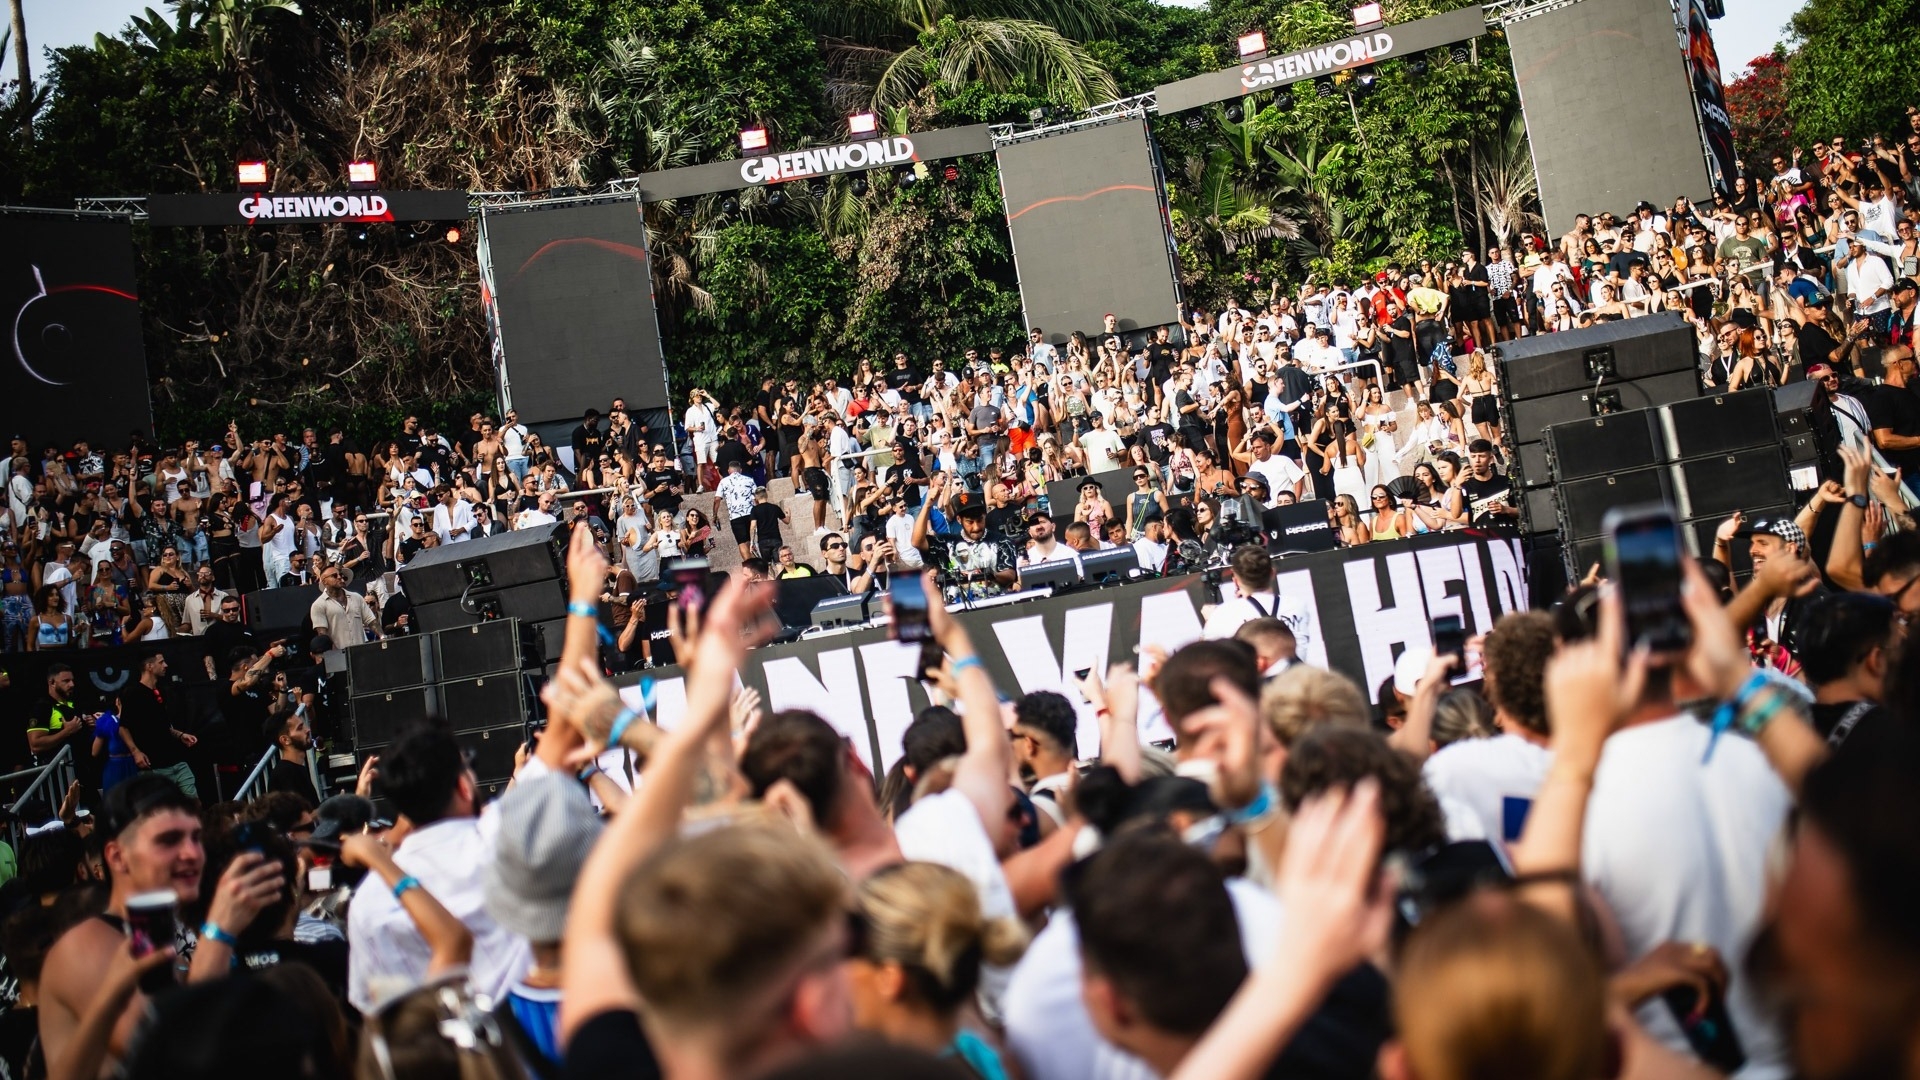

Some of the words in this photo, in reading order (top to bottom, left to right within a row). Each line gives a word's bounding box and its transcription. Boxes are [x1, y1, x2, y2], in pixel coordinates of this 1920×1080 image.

[1240, 32, 1393, 88] GREENWORLD
[740, 137, 914, 184] GREENWORLD
[238, 195, 388, 219] GREENWORLD
